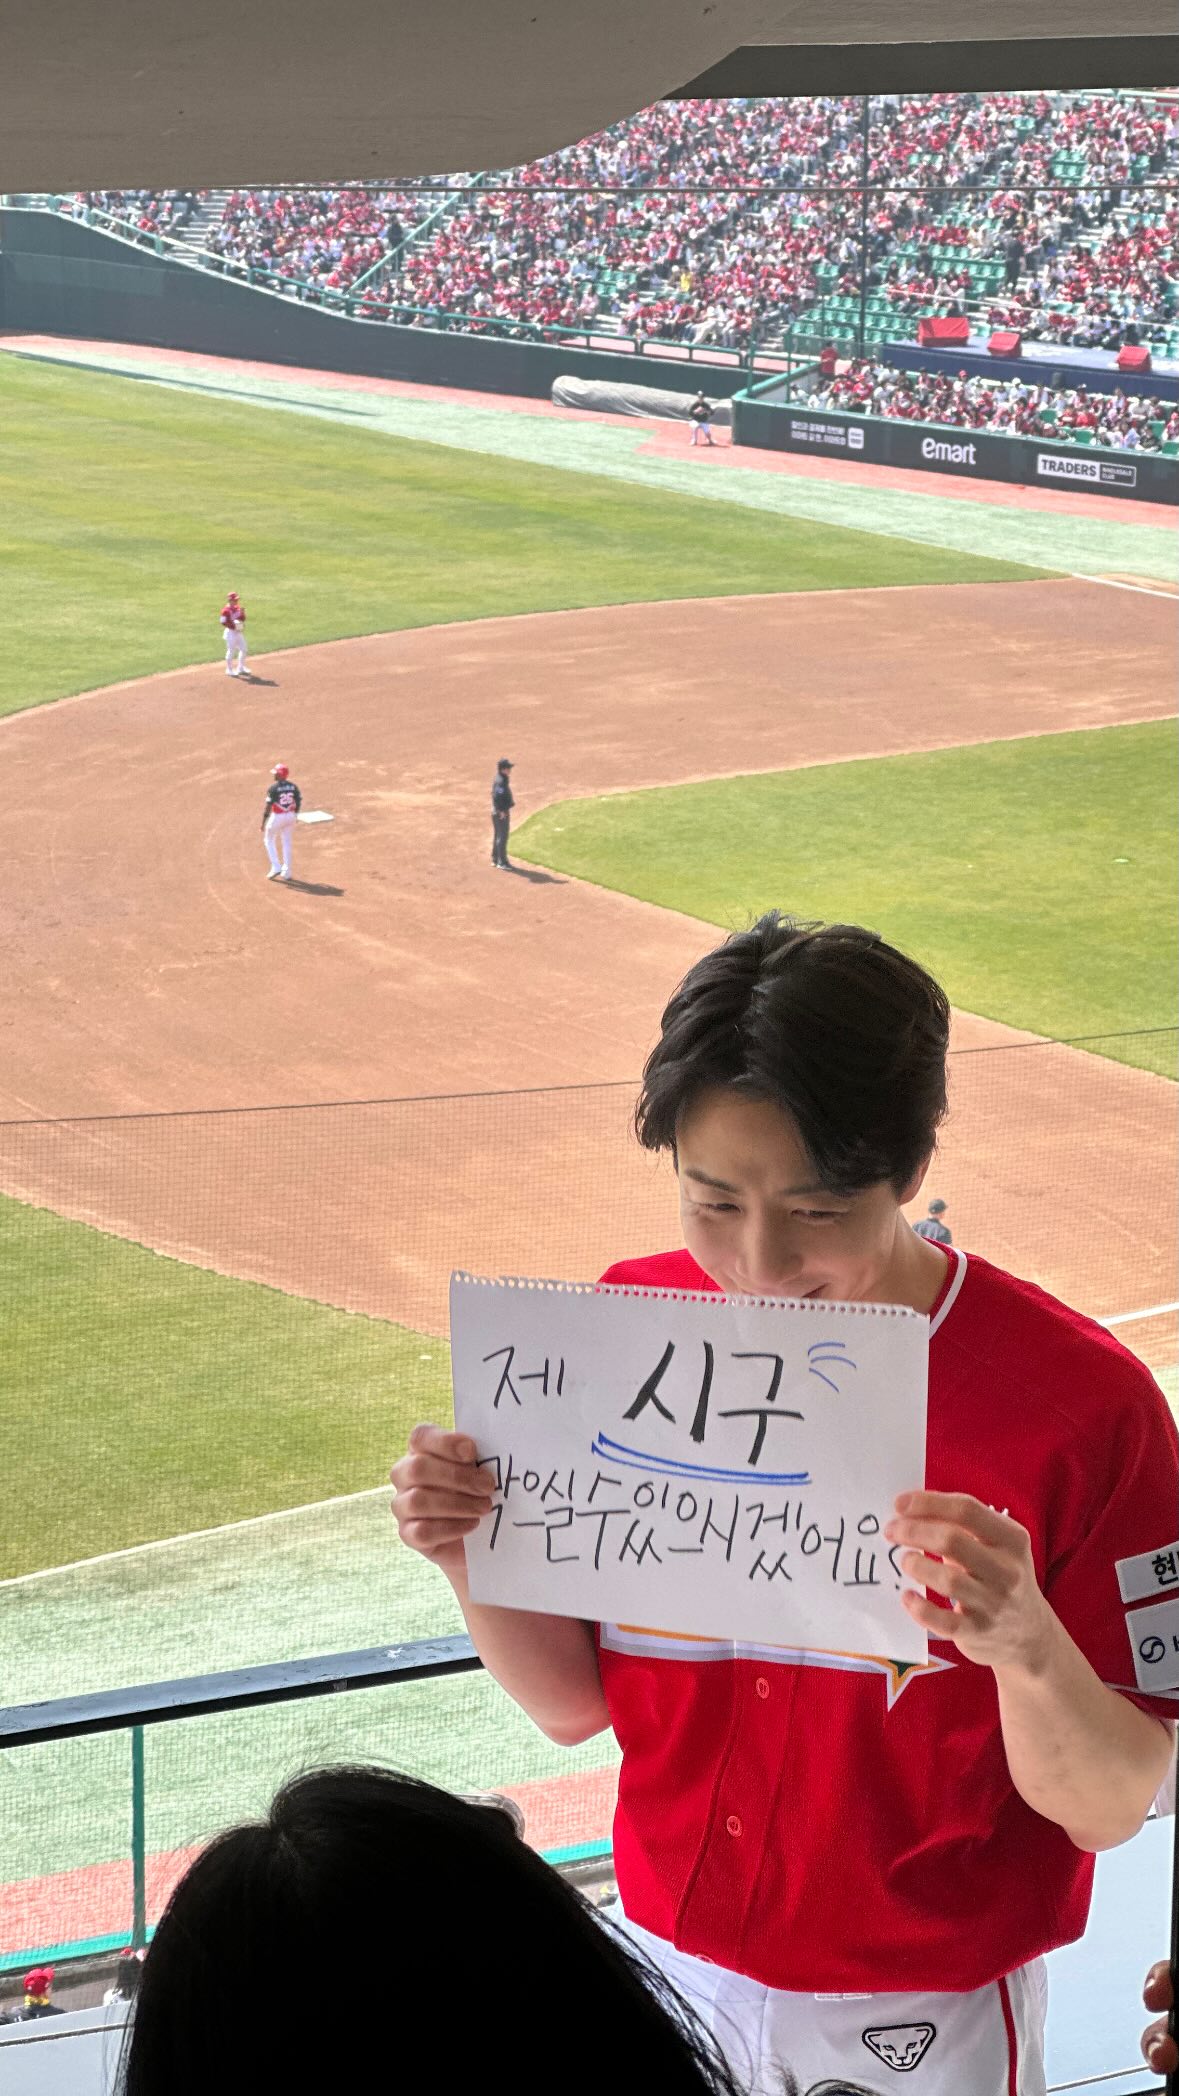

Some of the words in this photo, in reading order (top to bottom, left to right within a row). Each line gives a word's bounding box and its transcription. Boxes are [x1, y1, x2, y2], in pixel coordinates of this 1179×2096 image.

[921, 437, 976, 465] emart
[1041, 459, 1097, 477] TRADERS
[482, 1346, 565, 1408] 제
[622, 1340, 805, 1466] 시구
